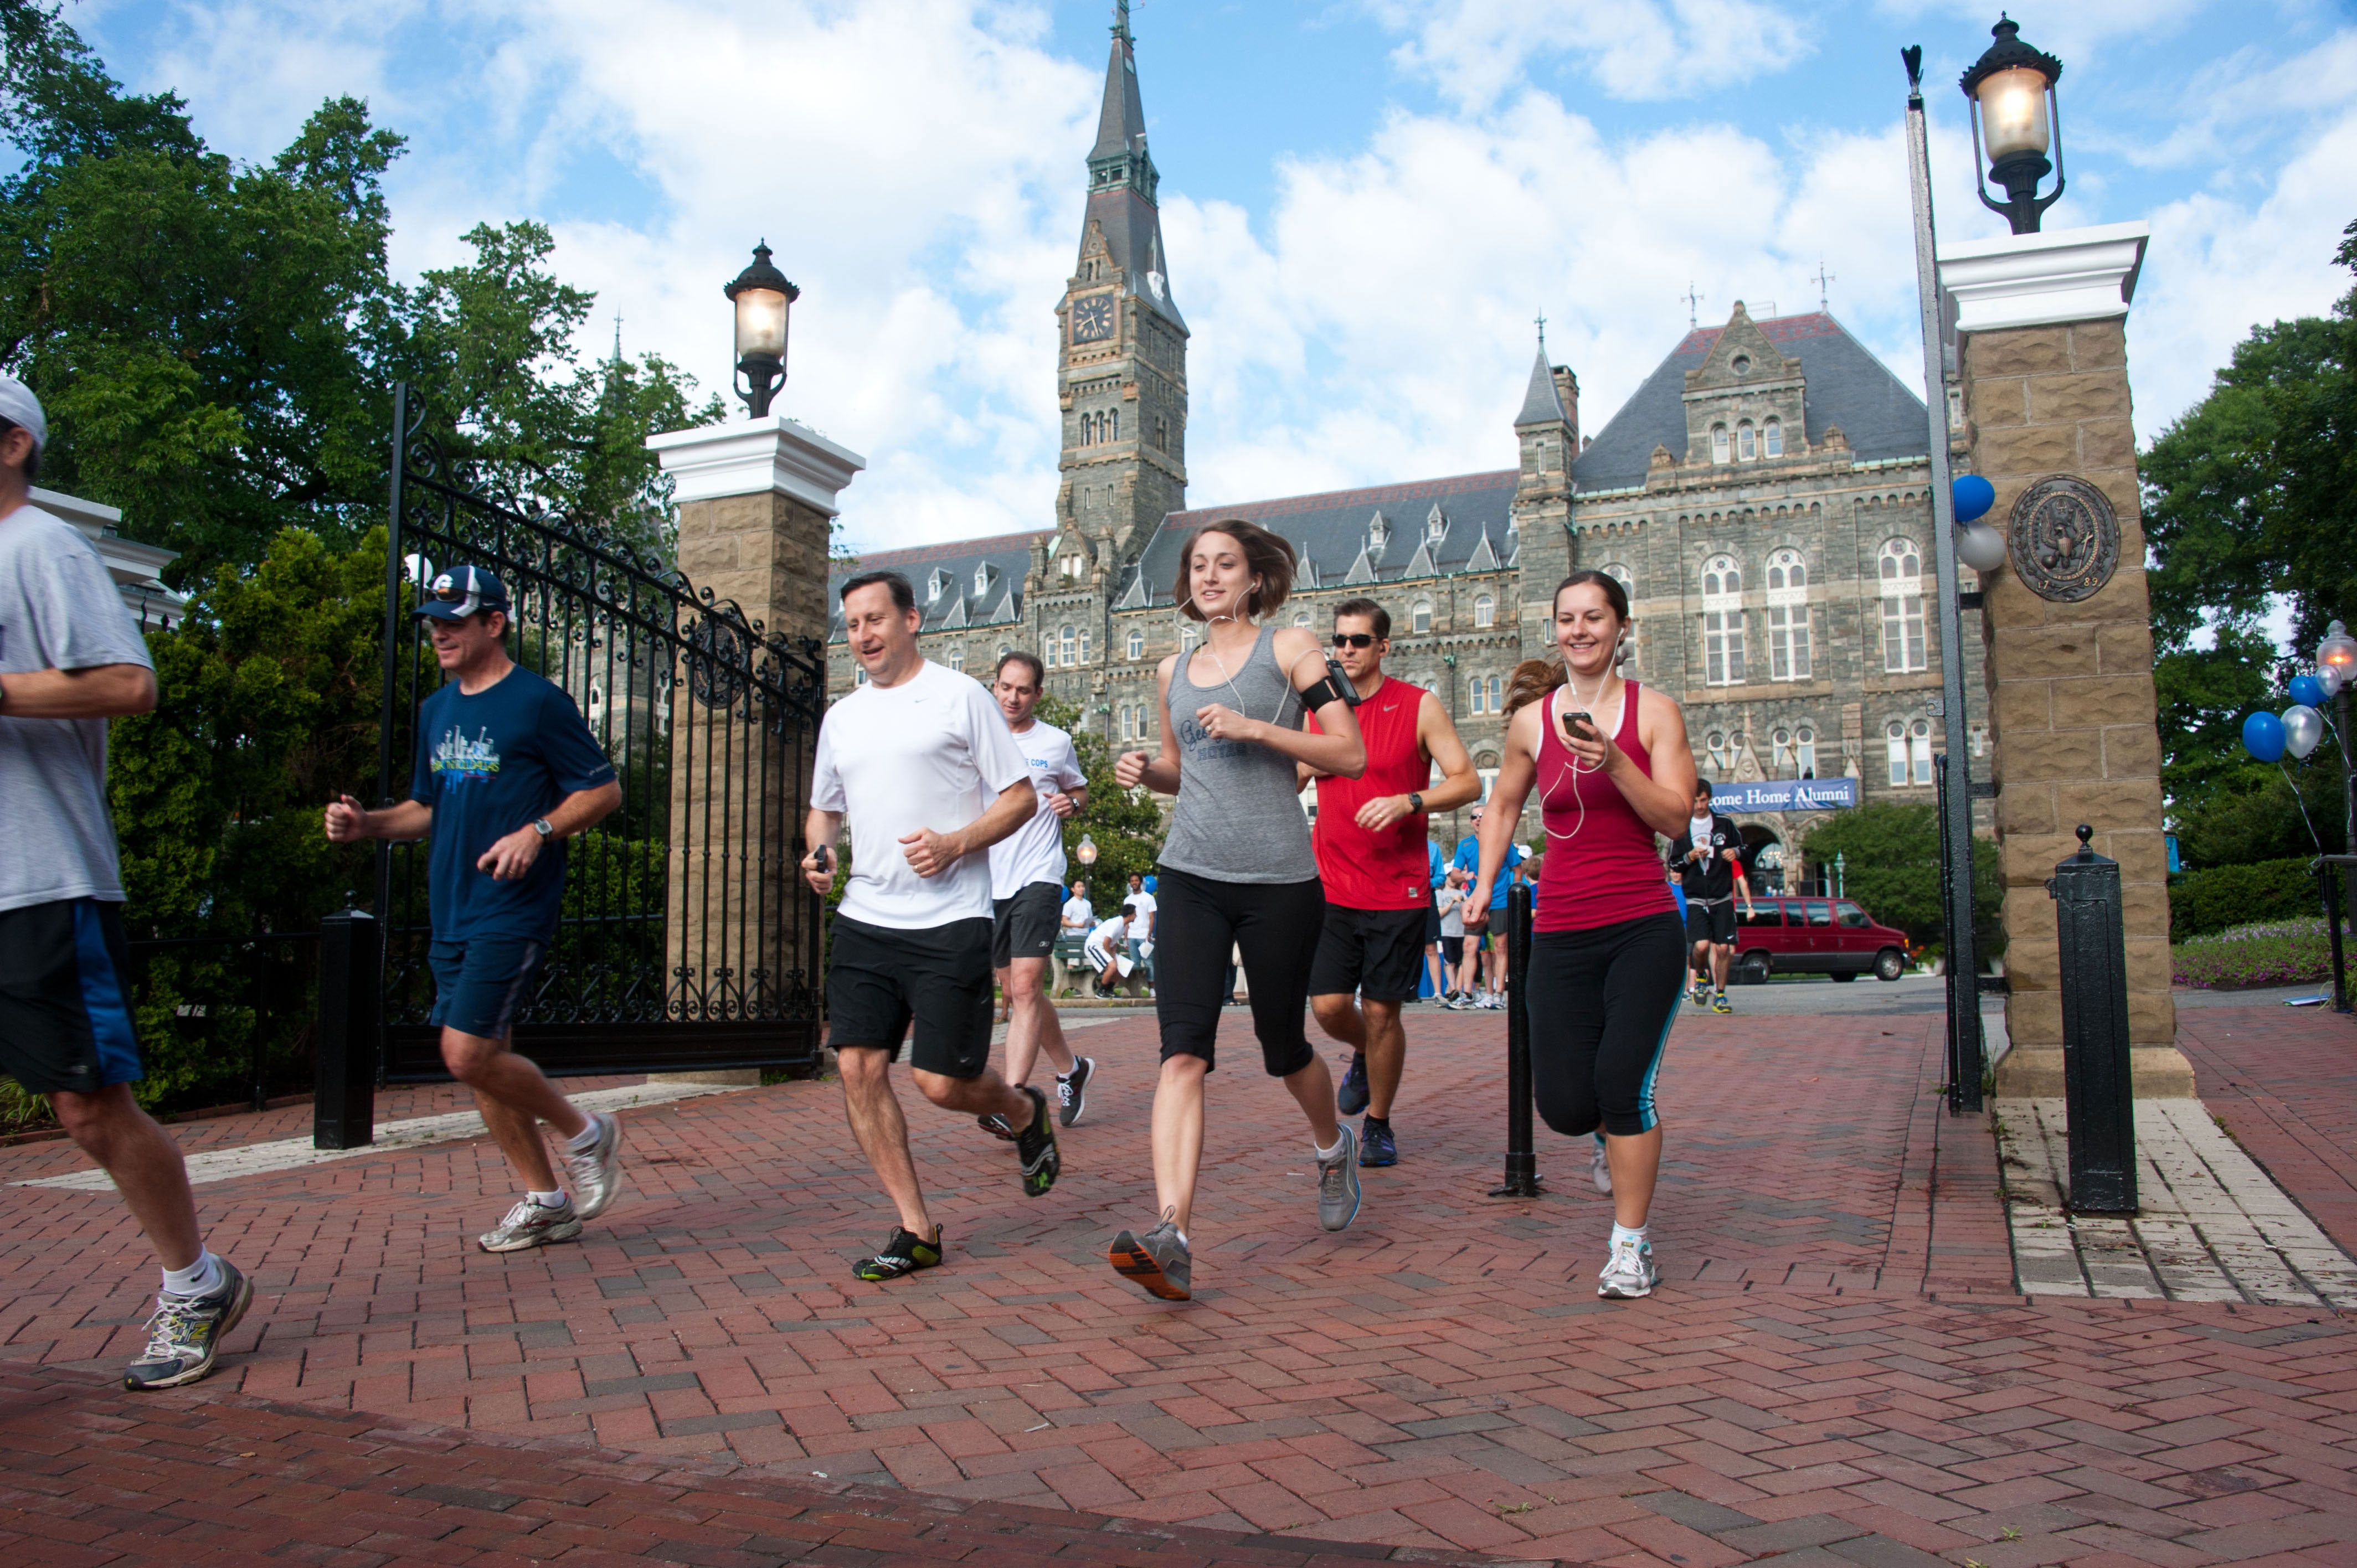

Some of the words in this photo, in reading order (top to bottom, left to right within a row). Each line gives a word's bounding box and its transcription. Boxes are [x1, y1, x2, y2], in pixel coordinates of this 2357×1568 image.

[2037, 580, 2049, 590] 17
[2084, 577, 2098, 587] 89
[1197, 743, 1246, 761] HOYAS
[1031, 759, 1048, 768] COPS
[1746, 789, 1791, 804] Home
[1794, 786, 1849, 802] Alumni
